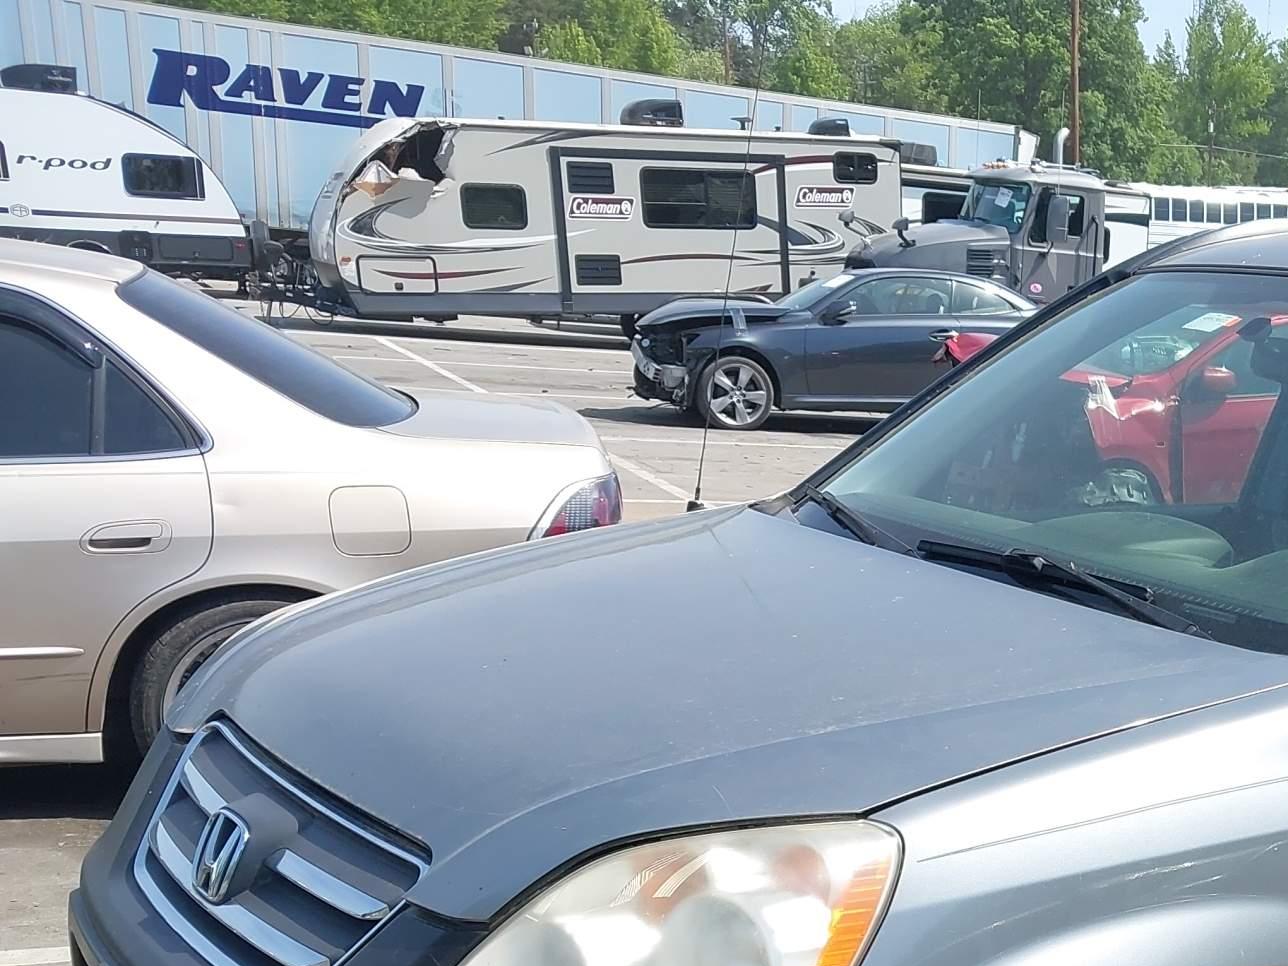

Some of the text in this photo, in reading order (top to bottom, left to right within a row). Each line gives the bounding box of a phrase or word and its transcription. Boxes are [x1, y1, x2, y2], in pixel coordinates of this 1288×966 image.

[147, 48, 425, 118] RAVEN
[799, 187, 844, 204] Coleman
[572, 198, 621, 215] Coleman
